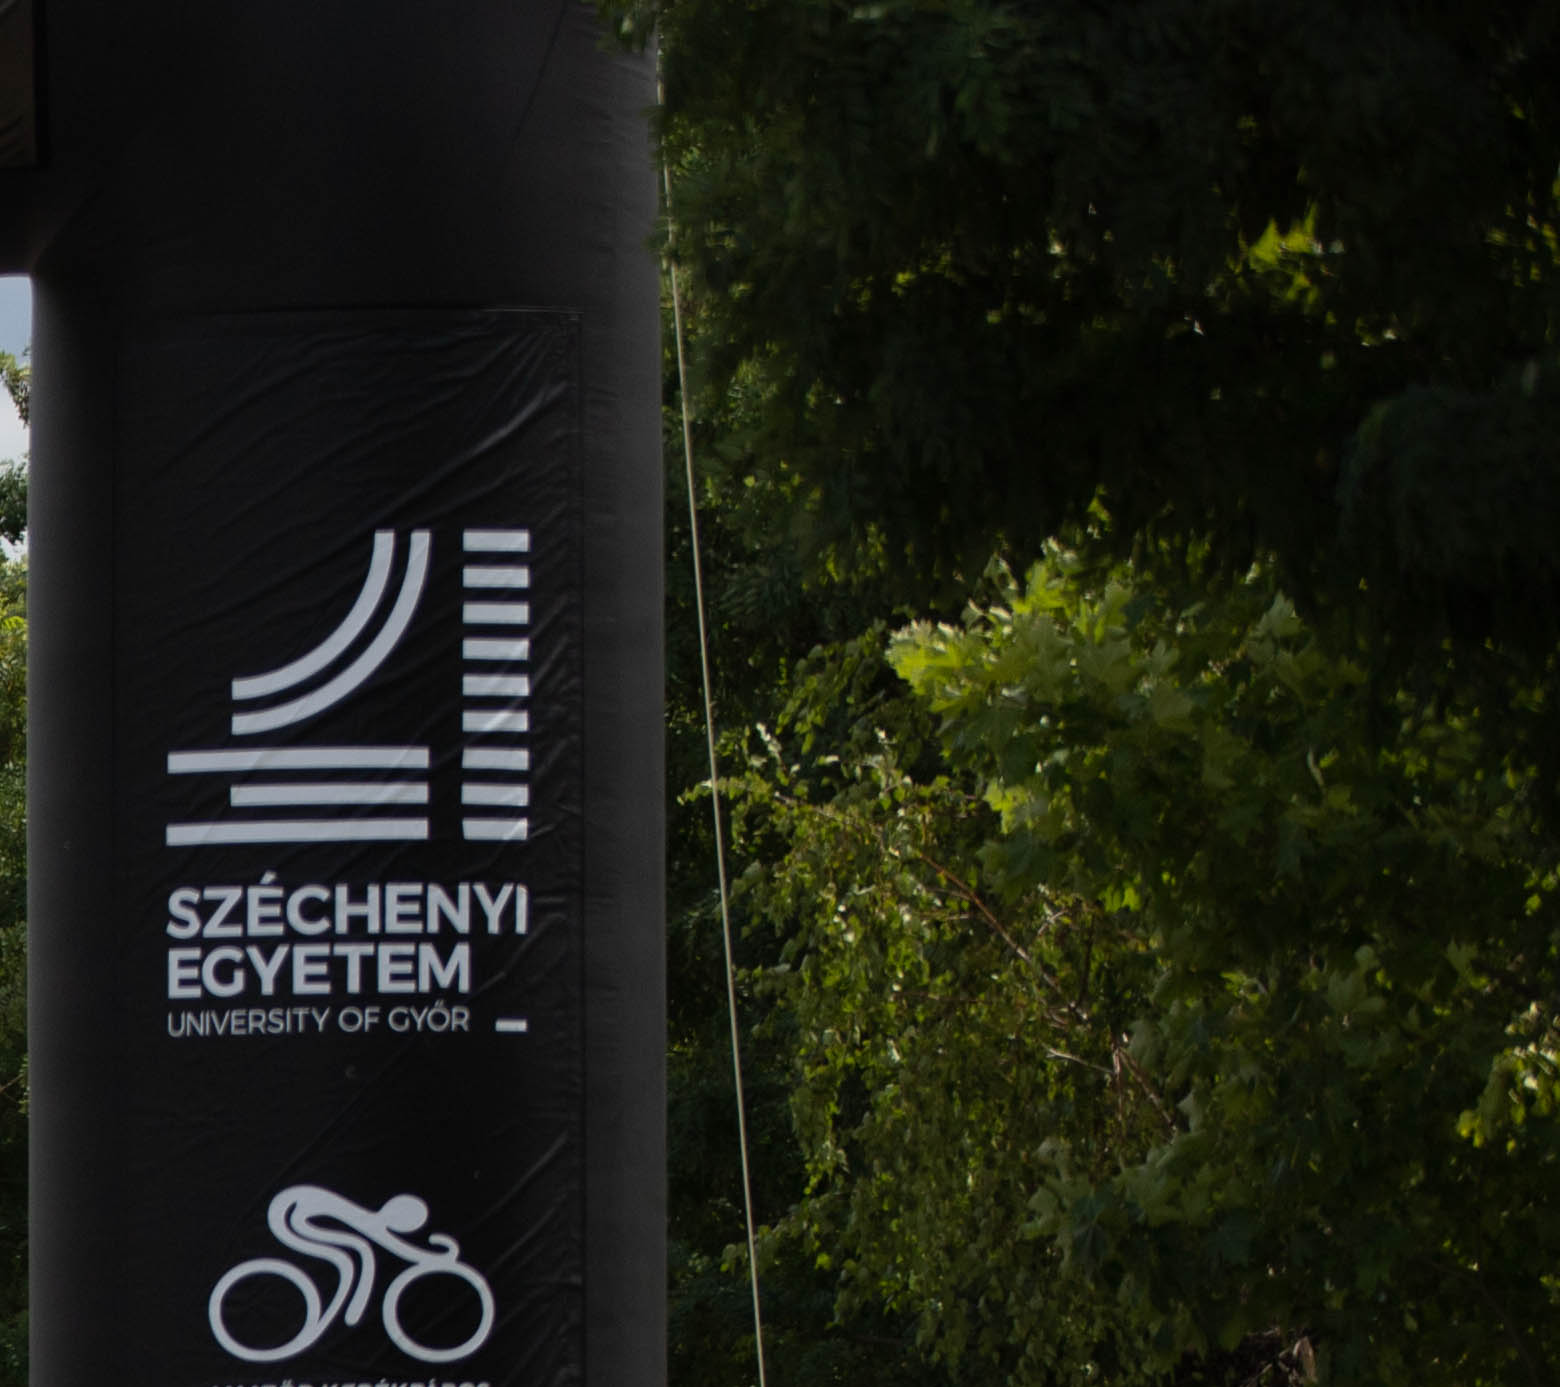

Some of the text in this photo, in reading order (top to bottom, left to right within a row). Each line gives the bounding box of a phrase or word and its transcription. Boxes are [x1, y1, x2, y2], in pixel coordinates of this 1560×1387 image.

[166, 871, 529, 939] SZÉCHENYI
[167, 941, 470, 999] EGYETEM
[168, 1000, 470, 1037] UNIVERSITY OF GYŐR
